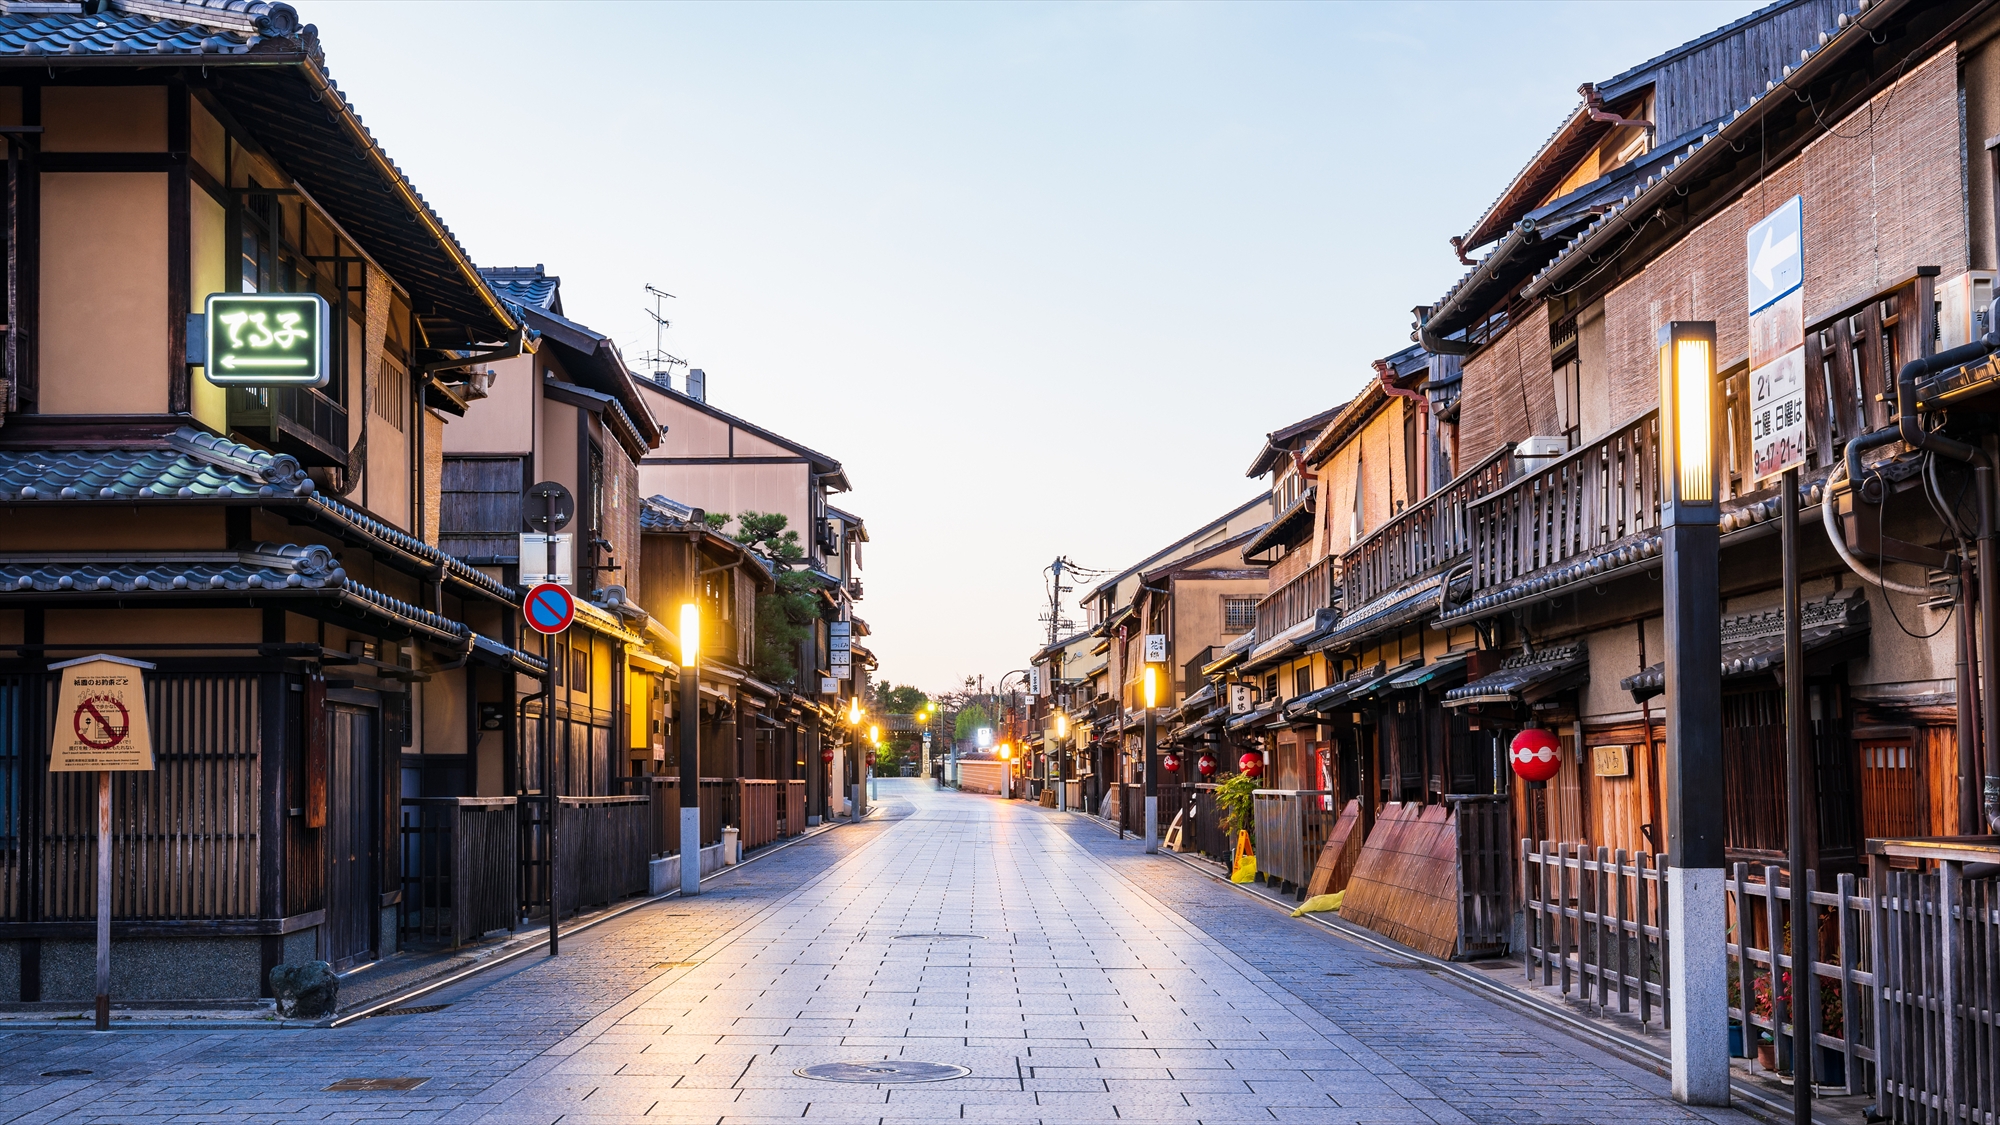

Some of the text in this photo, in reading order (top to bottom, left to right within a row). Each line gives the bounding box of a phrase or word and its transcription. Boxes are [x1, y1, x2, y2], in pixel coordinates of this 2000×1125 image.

[219, 311, 309, 349] てる子
[1754, 398, 1803, 441] 土曜、日曜は
